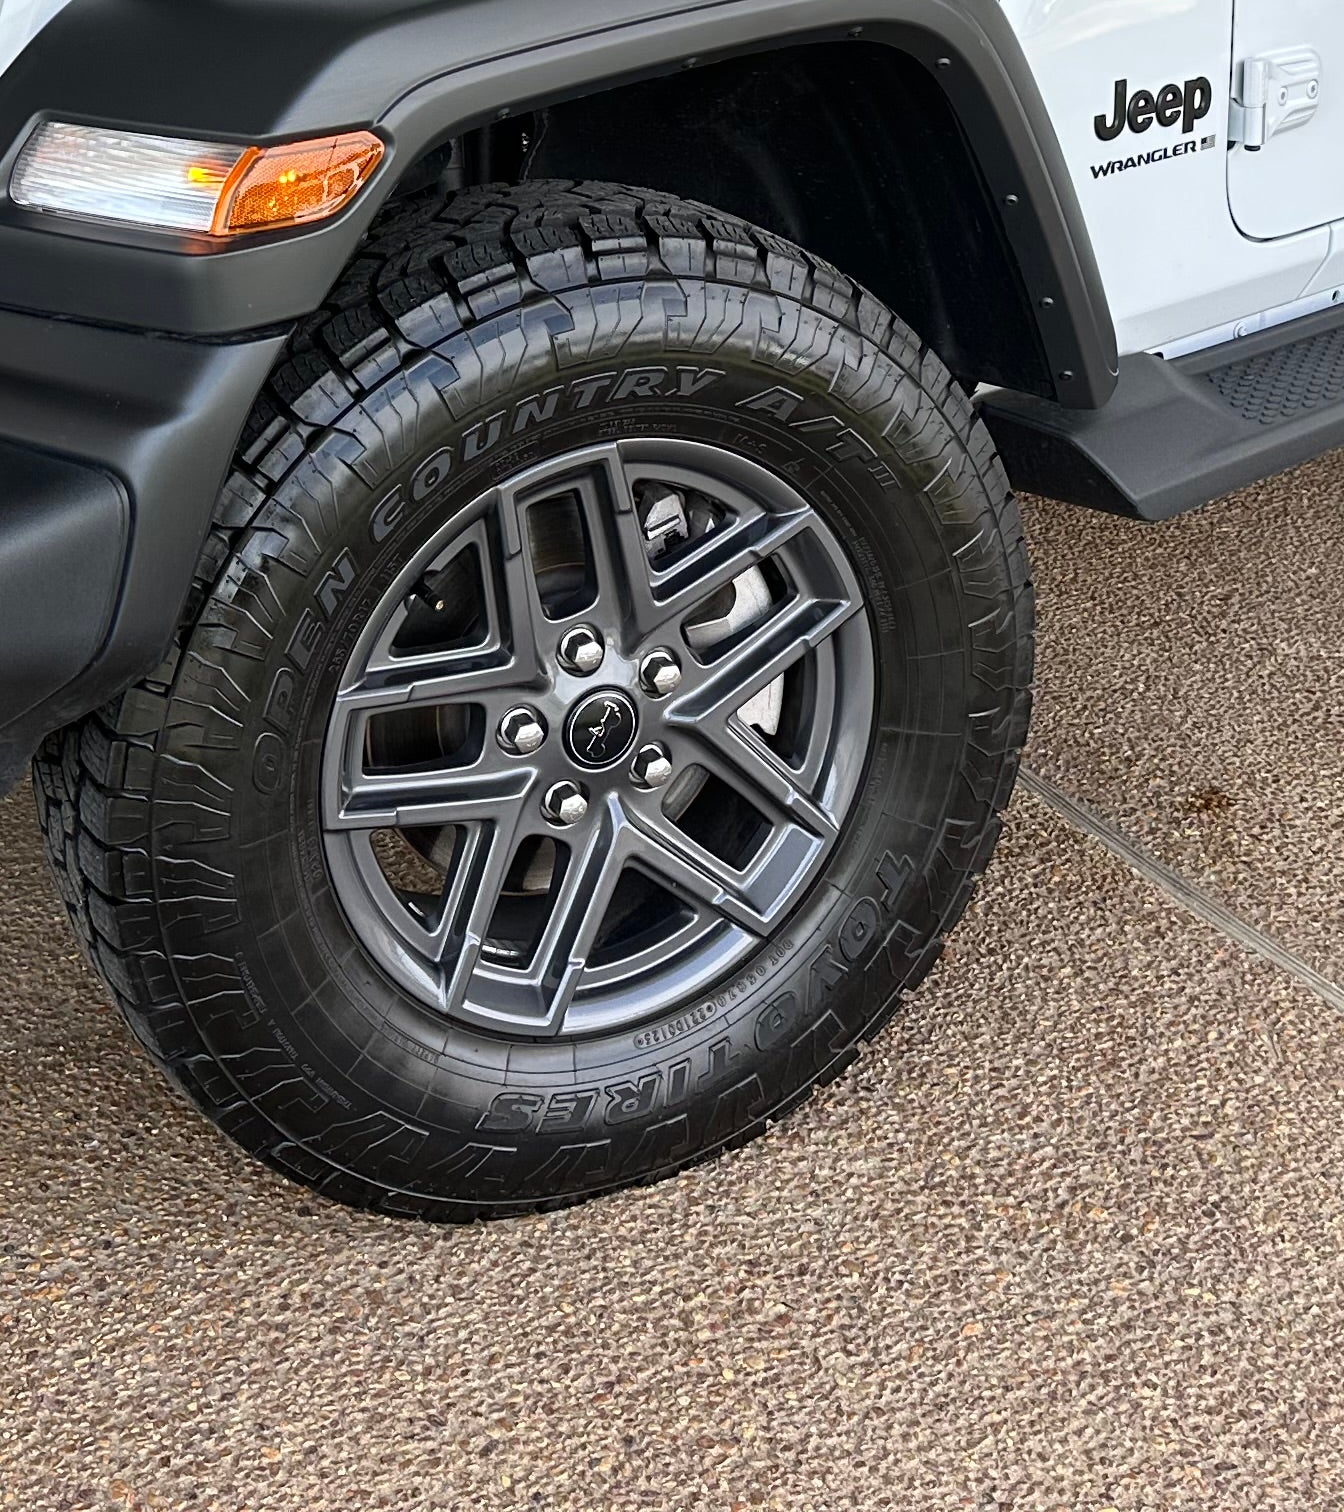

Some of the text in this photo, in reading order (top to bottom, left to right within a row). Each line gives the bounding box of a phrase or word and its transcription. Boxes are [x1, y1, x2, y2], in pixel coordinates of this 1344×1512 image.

[1090, 140, 1197, 179] WRANGLER
[1094, 76, 1212, 141] Jeep
[253, 547, 358, 794] OPEN
[369, 366, 726, 544] COUNTRY
[475, 849, 915, 1135] TOYO TIRES
